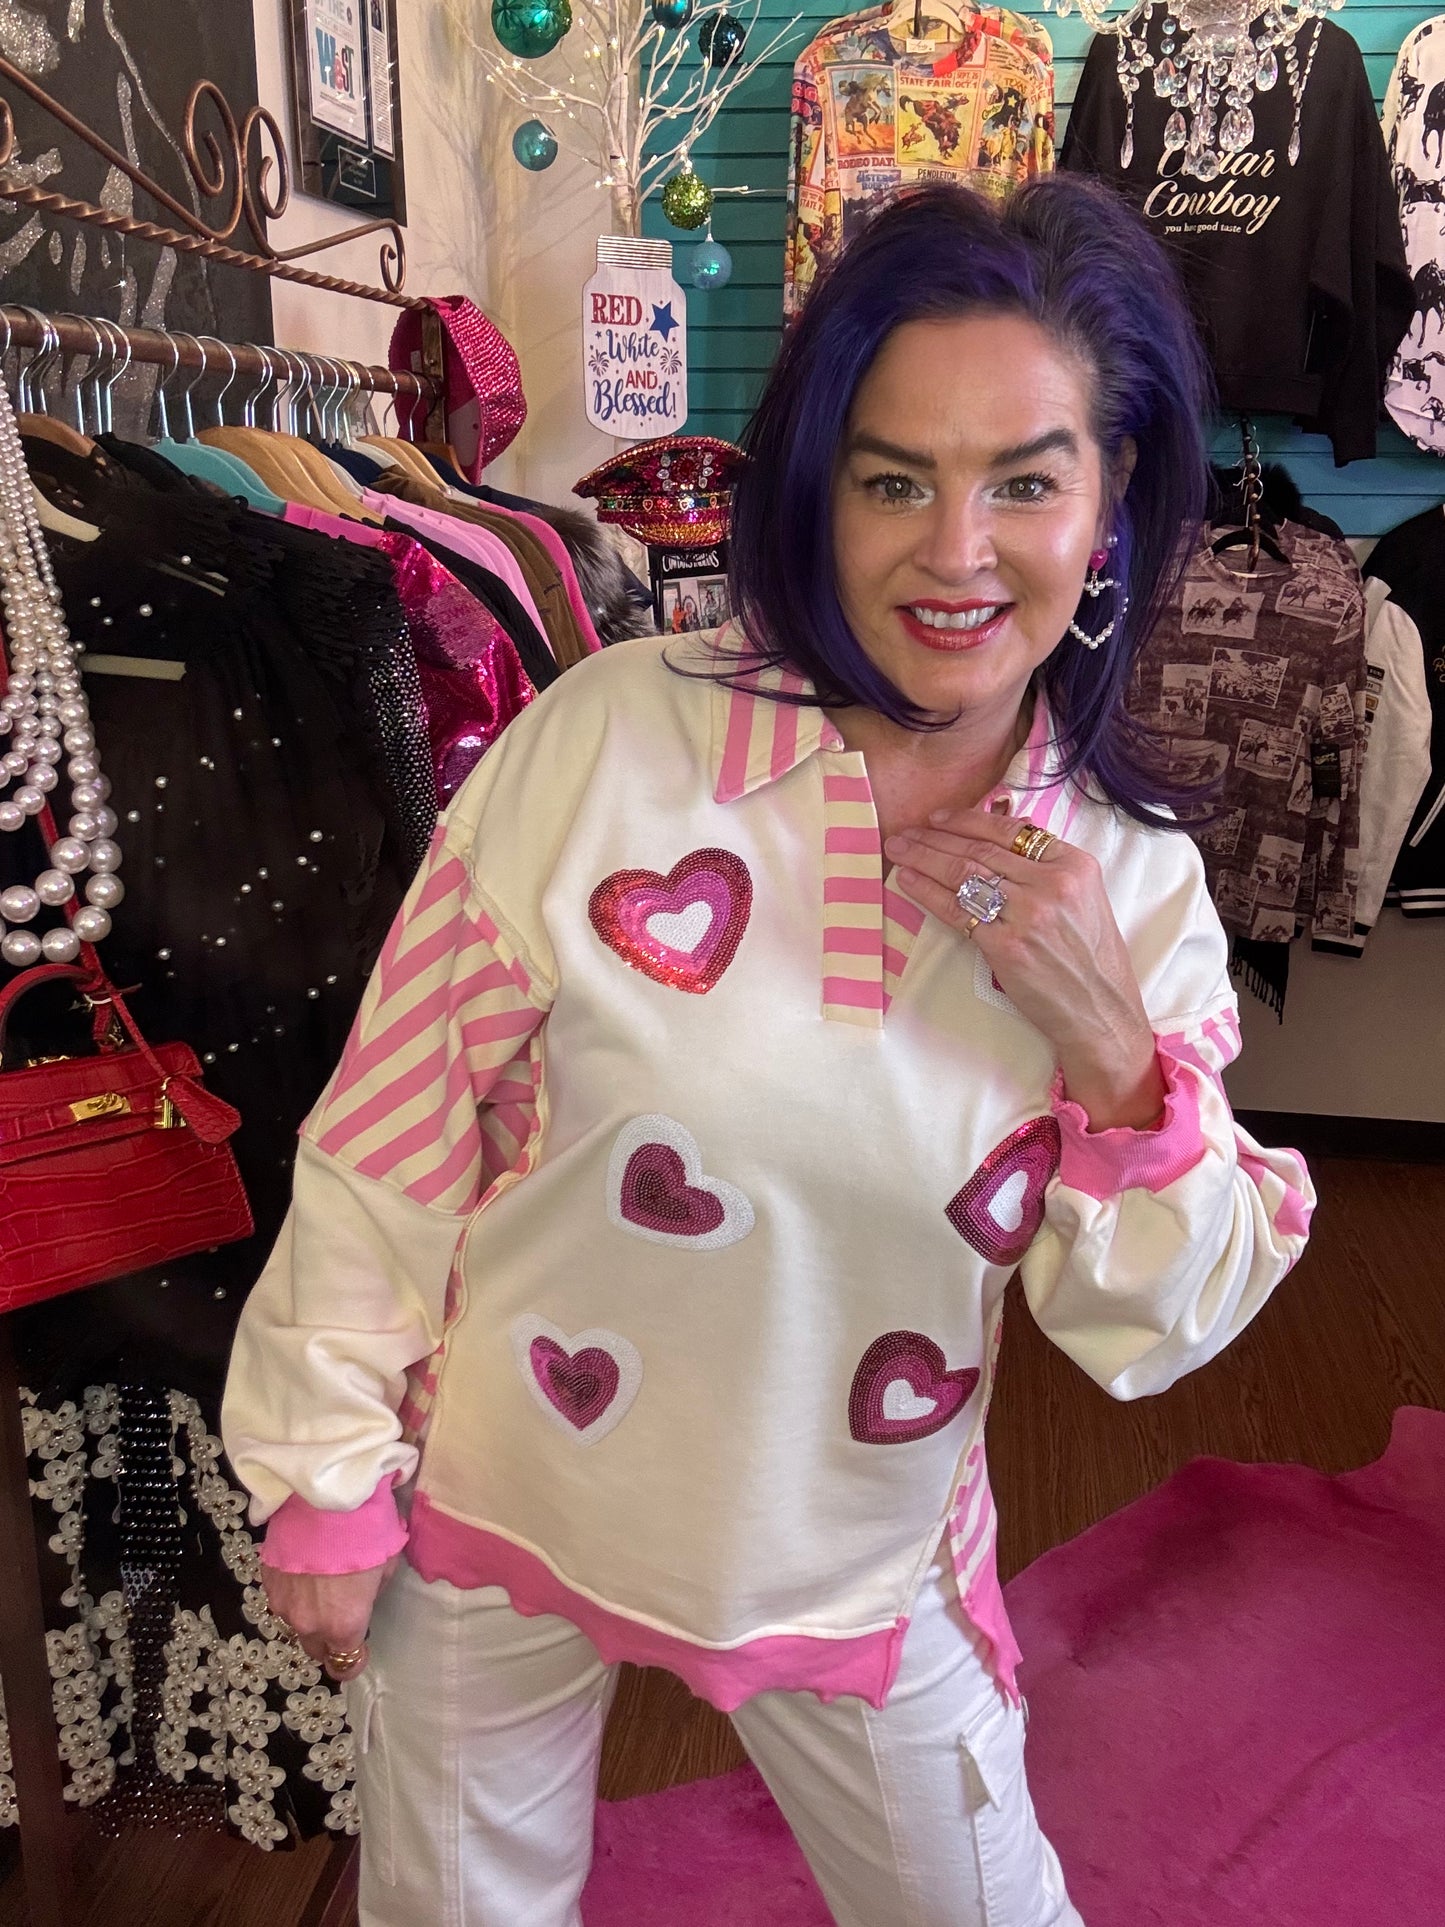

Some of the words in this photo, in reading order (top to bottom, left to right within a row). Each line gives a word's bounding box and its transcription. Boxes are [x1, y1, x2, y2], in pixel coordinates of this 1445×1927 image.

[901, 77, 924, 87] STATE
[927, 79, 952, 88] FAIR
[917, 168, 958, 180] PENDLETON
[1143, 180, 1280, 234] Cowboy
[1164, 225, 1182, 235] you
[1197, 221, 1219, 234] good
[1220, 224, 1242, 234] taste
[590, 293, 643, 326] RED
[605, 328, 660, 363] White
[625, 370, 658, 390] AND
[592, 378, 677, 421] Blessed!
